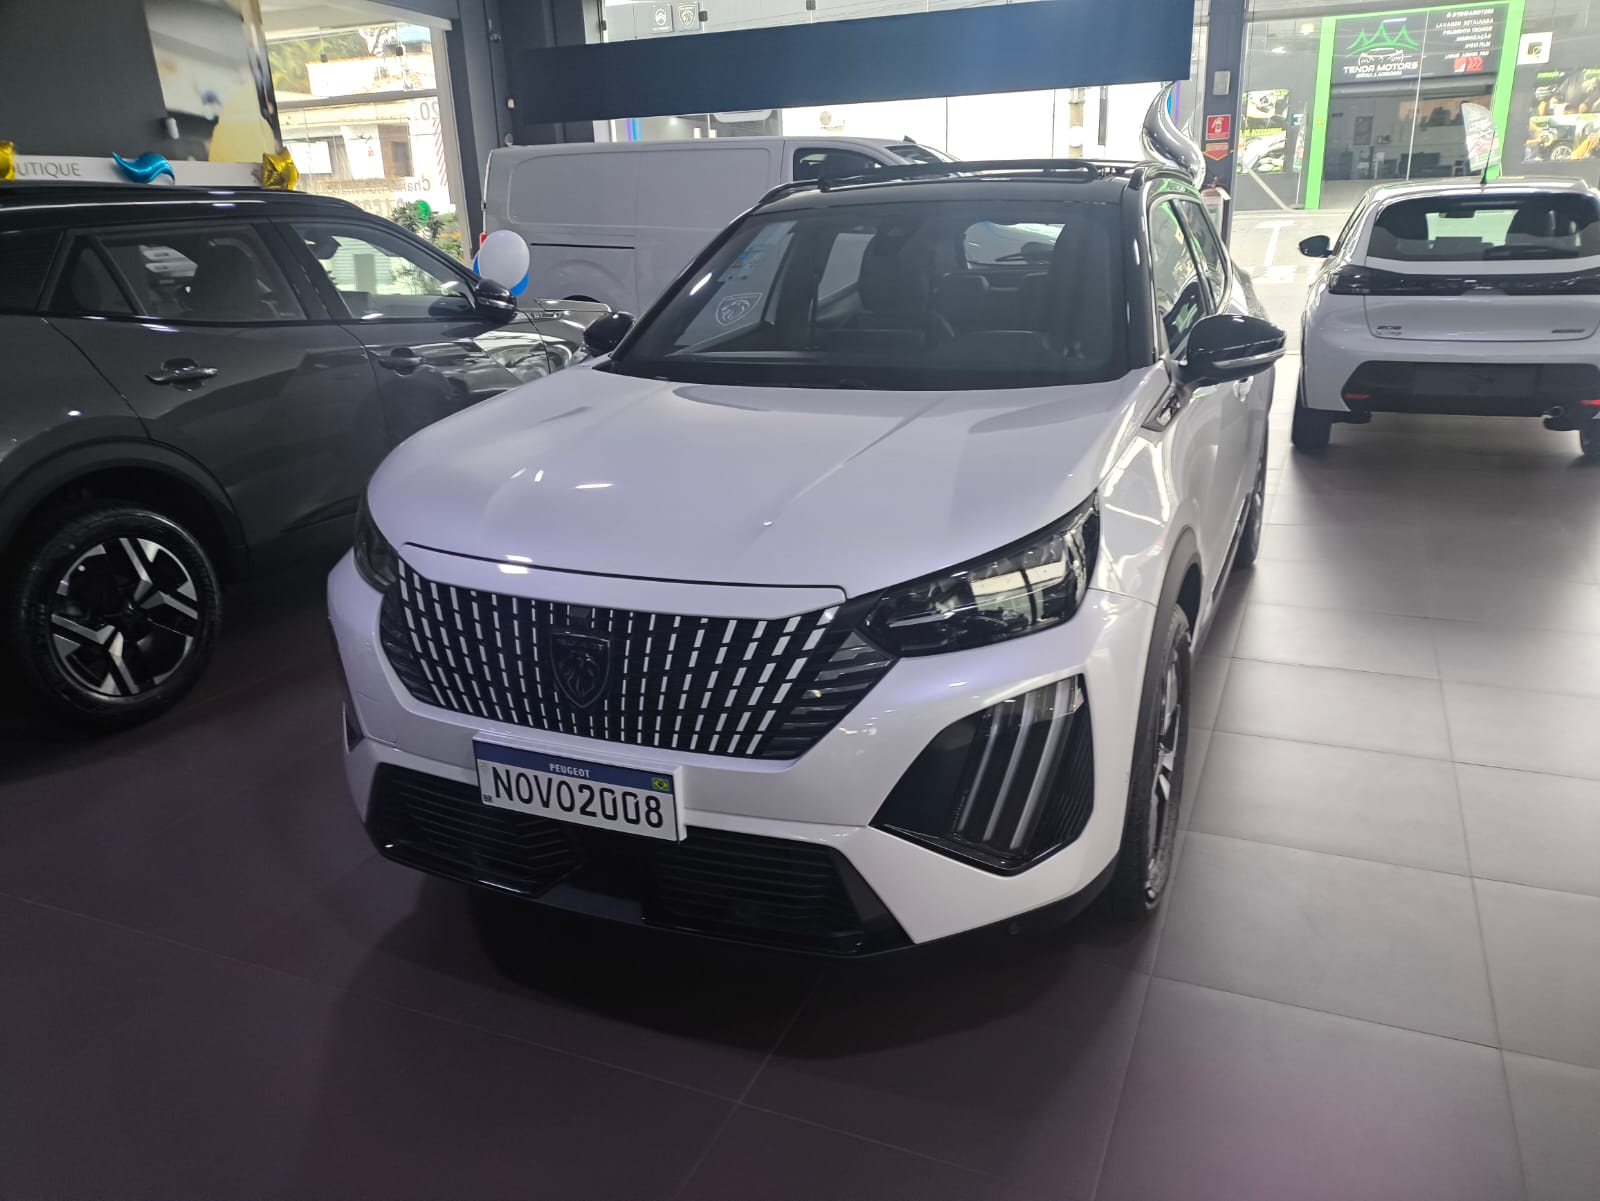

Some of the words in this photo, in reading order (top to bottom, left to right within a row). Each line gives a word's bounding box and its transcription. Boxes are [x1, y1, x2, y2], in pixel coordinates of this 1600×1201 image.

[1376, 61, 1418, 72] MOTORS
[15, 162, 80, 178] UTIQUE
[549, 763, 590, 778] PEUGEOT
[492, 766, 663, 828] NOVO2008
